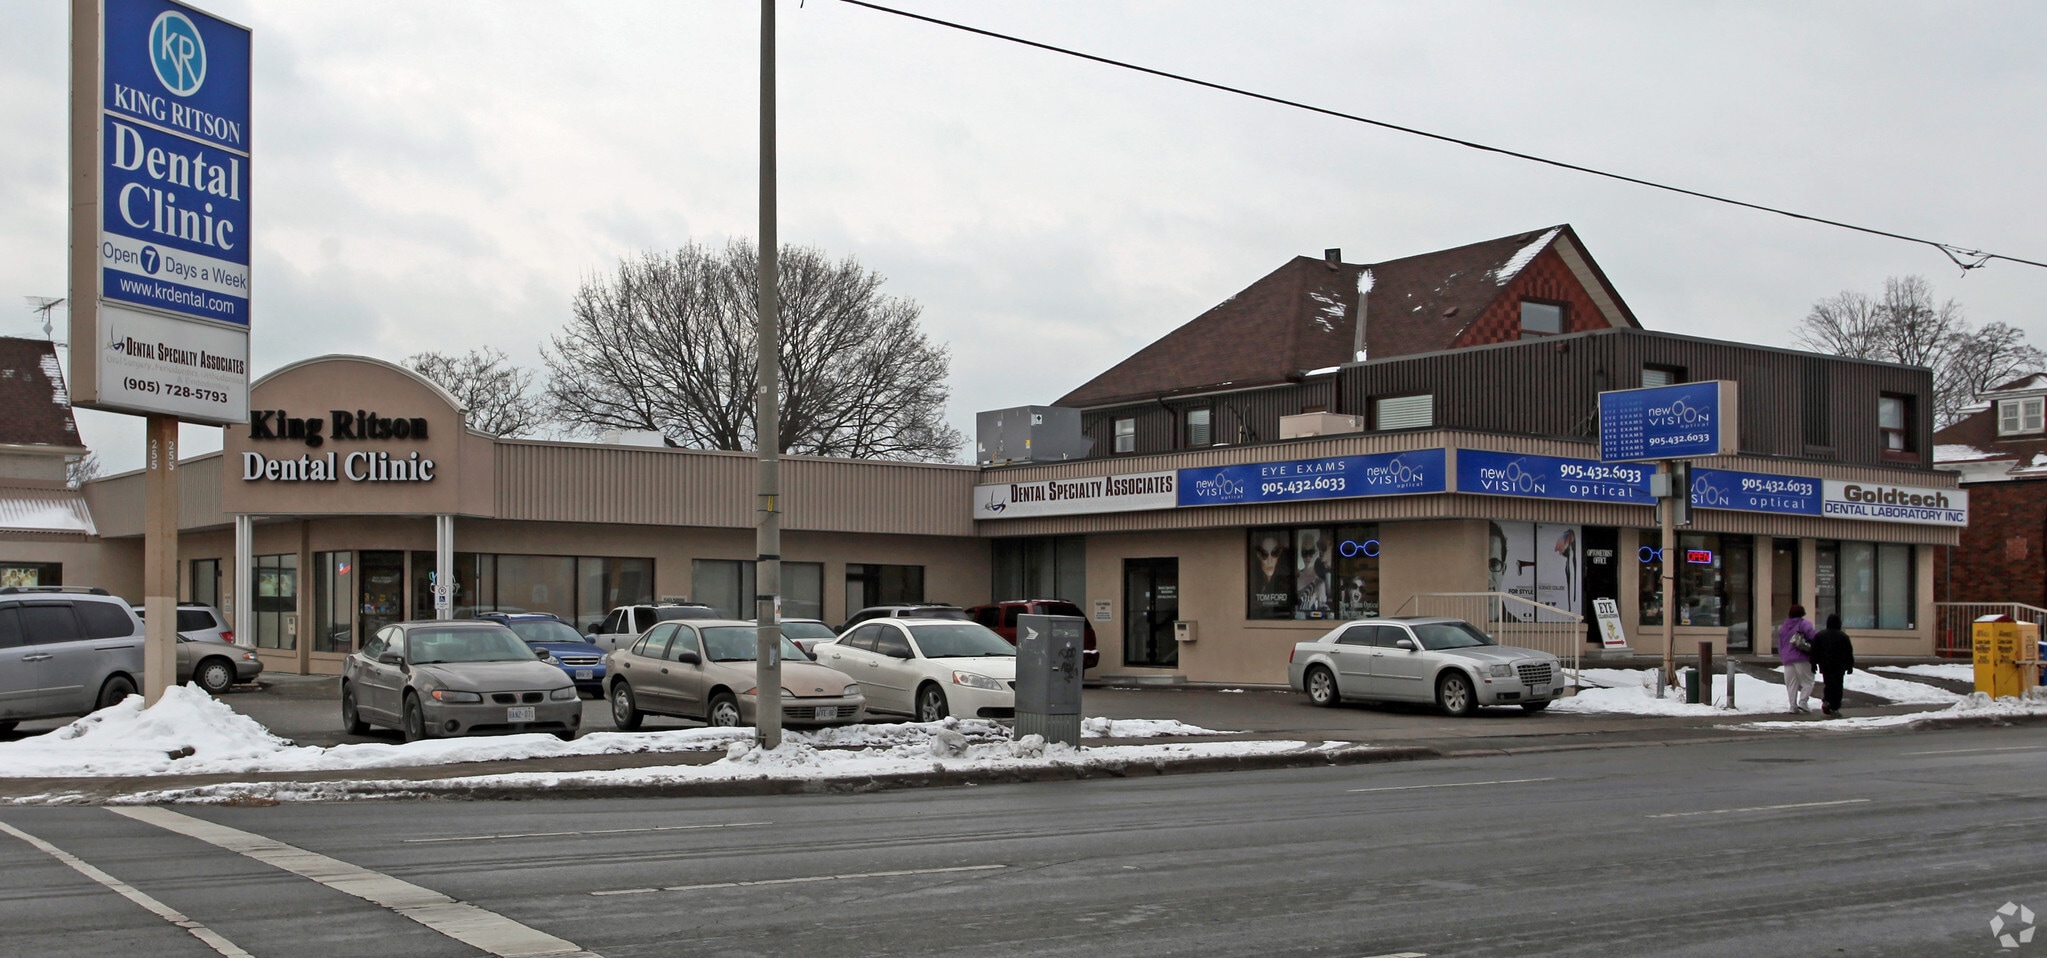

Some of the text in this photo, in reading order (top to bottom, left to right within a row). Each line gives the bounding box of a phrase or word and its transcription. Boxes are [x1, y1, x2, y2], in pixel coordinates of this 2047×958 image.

[114, 83, 240, 144] KING RITSON
[112, 121, 240, 201] Dental
[119, 182, 235, 250] Clinic
[103, 242, 247, 290] Open 7 Days a Week
[120, 278, 235, 314] www.krdental.com
[126, 337, 244, 374] DENTAL SPECIALTY ASSOCIATES
[123, 376, 228, 404] (905) 728-5793
[1649, 407, 1671, 417] new
[248, 409, 429, 447] King Ritson
[1649, 433, 1710, 446] 905.432.6033
[241, 451, 435, 482] Dental Clinic
[1262, 461, 1345, 477] EYE EXAMS
[1367, 466, 1389, 476] new
[1480, 467, 1506, 479] new
[1560, 464, 1642, 483] 905.432.6033
[1010, 475, 1173, 503] DENTAL SPECIALTY ASSOCIATES
[1196, 479, 1214, 489] new
[1261, 477, 1346, 496] 905.432.6033
[1480, 473, 1546, 494] VISION
[1569, 484, 1633, 497] optical
[1741, 478, 1813, 496] 905.432.6033
[1691, 486, 1729, 506] SION
[1750, 497, 1805, 509] optical
[1843, 485, 1949, 508] Goldtech
[1825, 503, 1966, 523] DENTAL LABORATORY INC.
[1687, 551, 1711, 562] OPEN
[1256, 593, 1287, 602] TOM FORD
[1598, 602, 1614, 613] EYE
